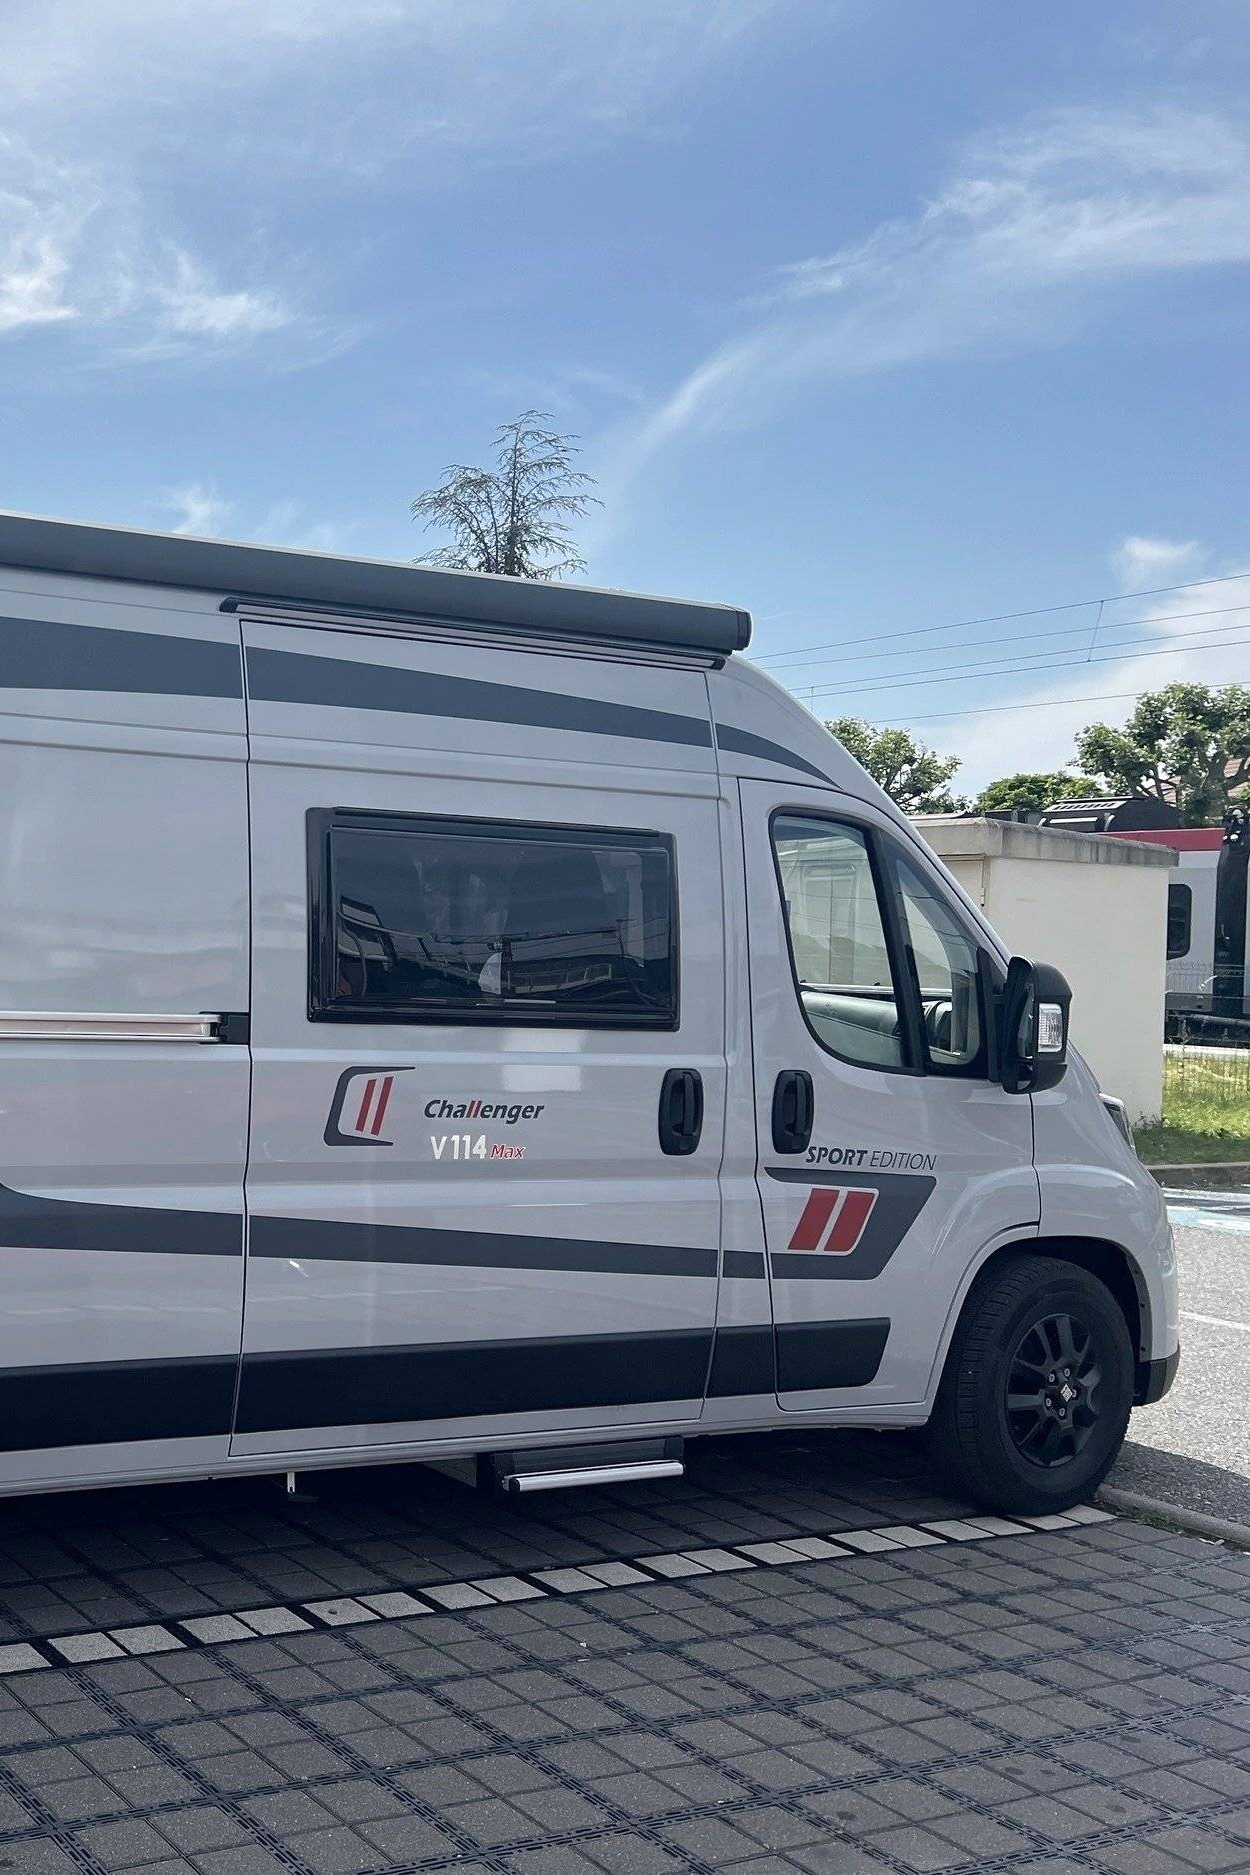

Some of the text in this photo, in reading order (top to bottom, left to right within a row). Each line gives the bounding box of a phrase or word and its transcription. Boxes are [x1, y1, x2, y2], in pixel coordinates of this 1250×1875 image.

[424, 1099, 545, 1125] Challenger
[490, 1144, 526, 1160] Max
[806, 1146, 937, 1171] SPORT EDITION
